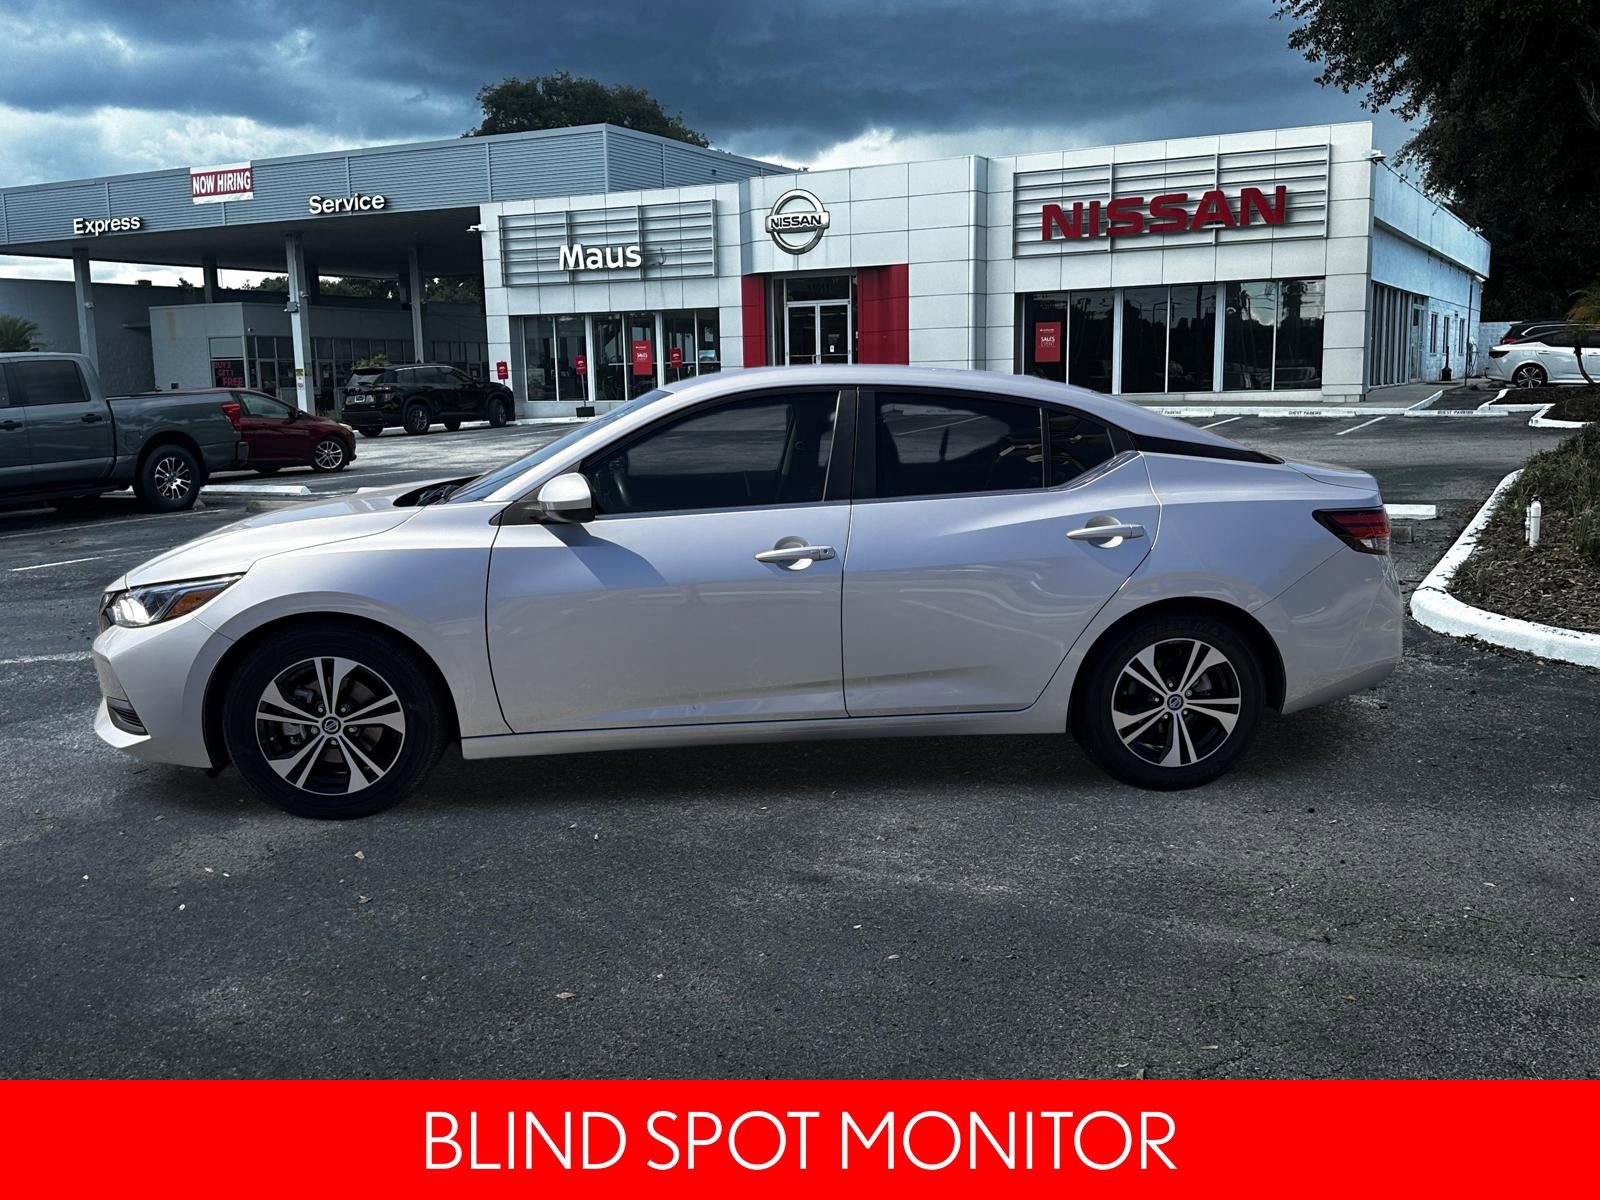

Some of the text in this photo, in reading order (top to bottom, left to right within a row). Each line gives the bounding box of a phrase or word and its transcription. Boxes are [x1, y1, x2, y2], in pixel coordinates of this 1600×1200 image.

[193, 171, 251, 195] NOW HIRING
[308, 193, 385, 215] Service
[1041, 185, 1287, 241] NISSAN
[73, 216, 141, 236] Express
[770, 214, 822, 230] NISSAN
[559, 243, 642, 271] Maus
